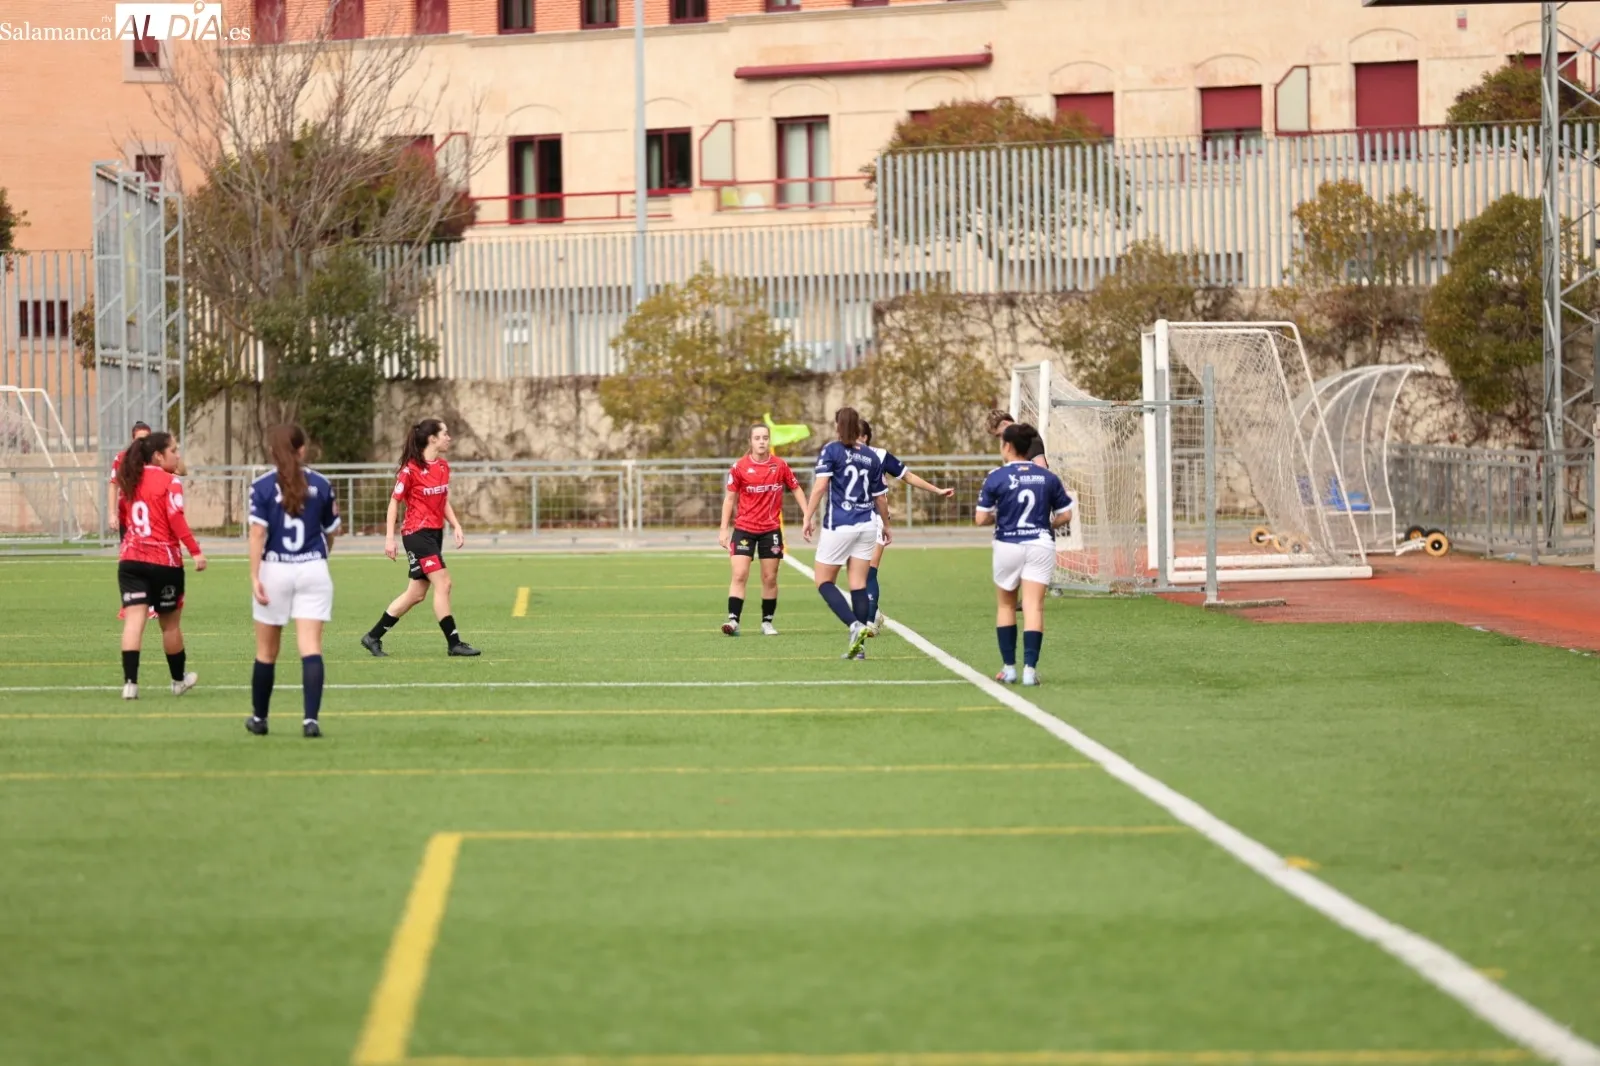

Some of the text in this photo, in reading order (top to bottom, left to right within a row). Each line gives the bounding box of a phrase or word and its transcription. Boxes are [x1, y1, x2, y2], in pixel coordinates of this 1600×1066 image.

[843, 464, 870, 503] 21
[131, 500, 151, 537] 9
[1017, 488, 1036, 528] 2
[282, 513, 305, 552] 5
[773, 534, 779, 545] 5
